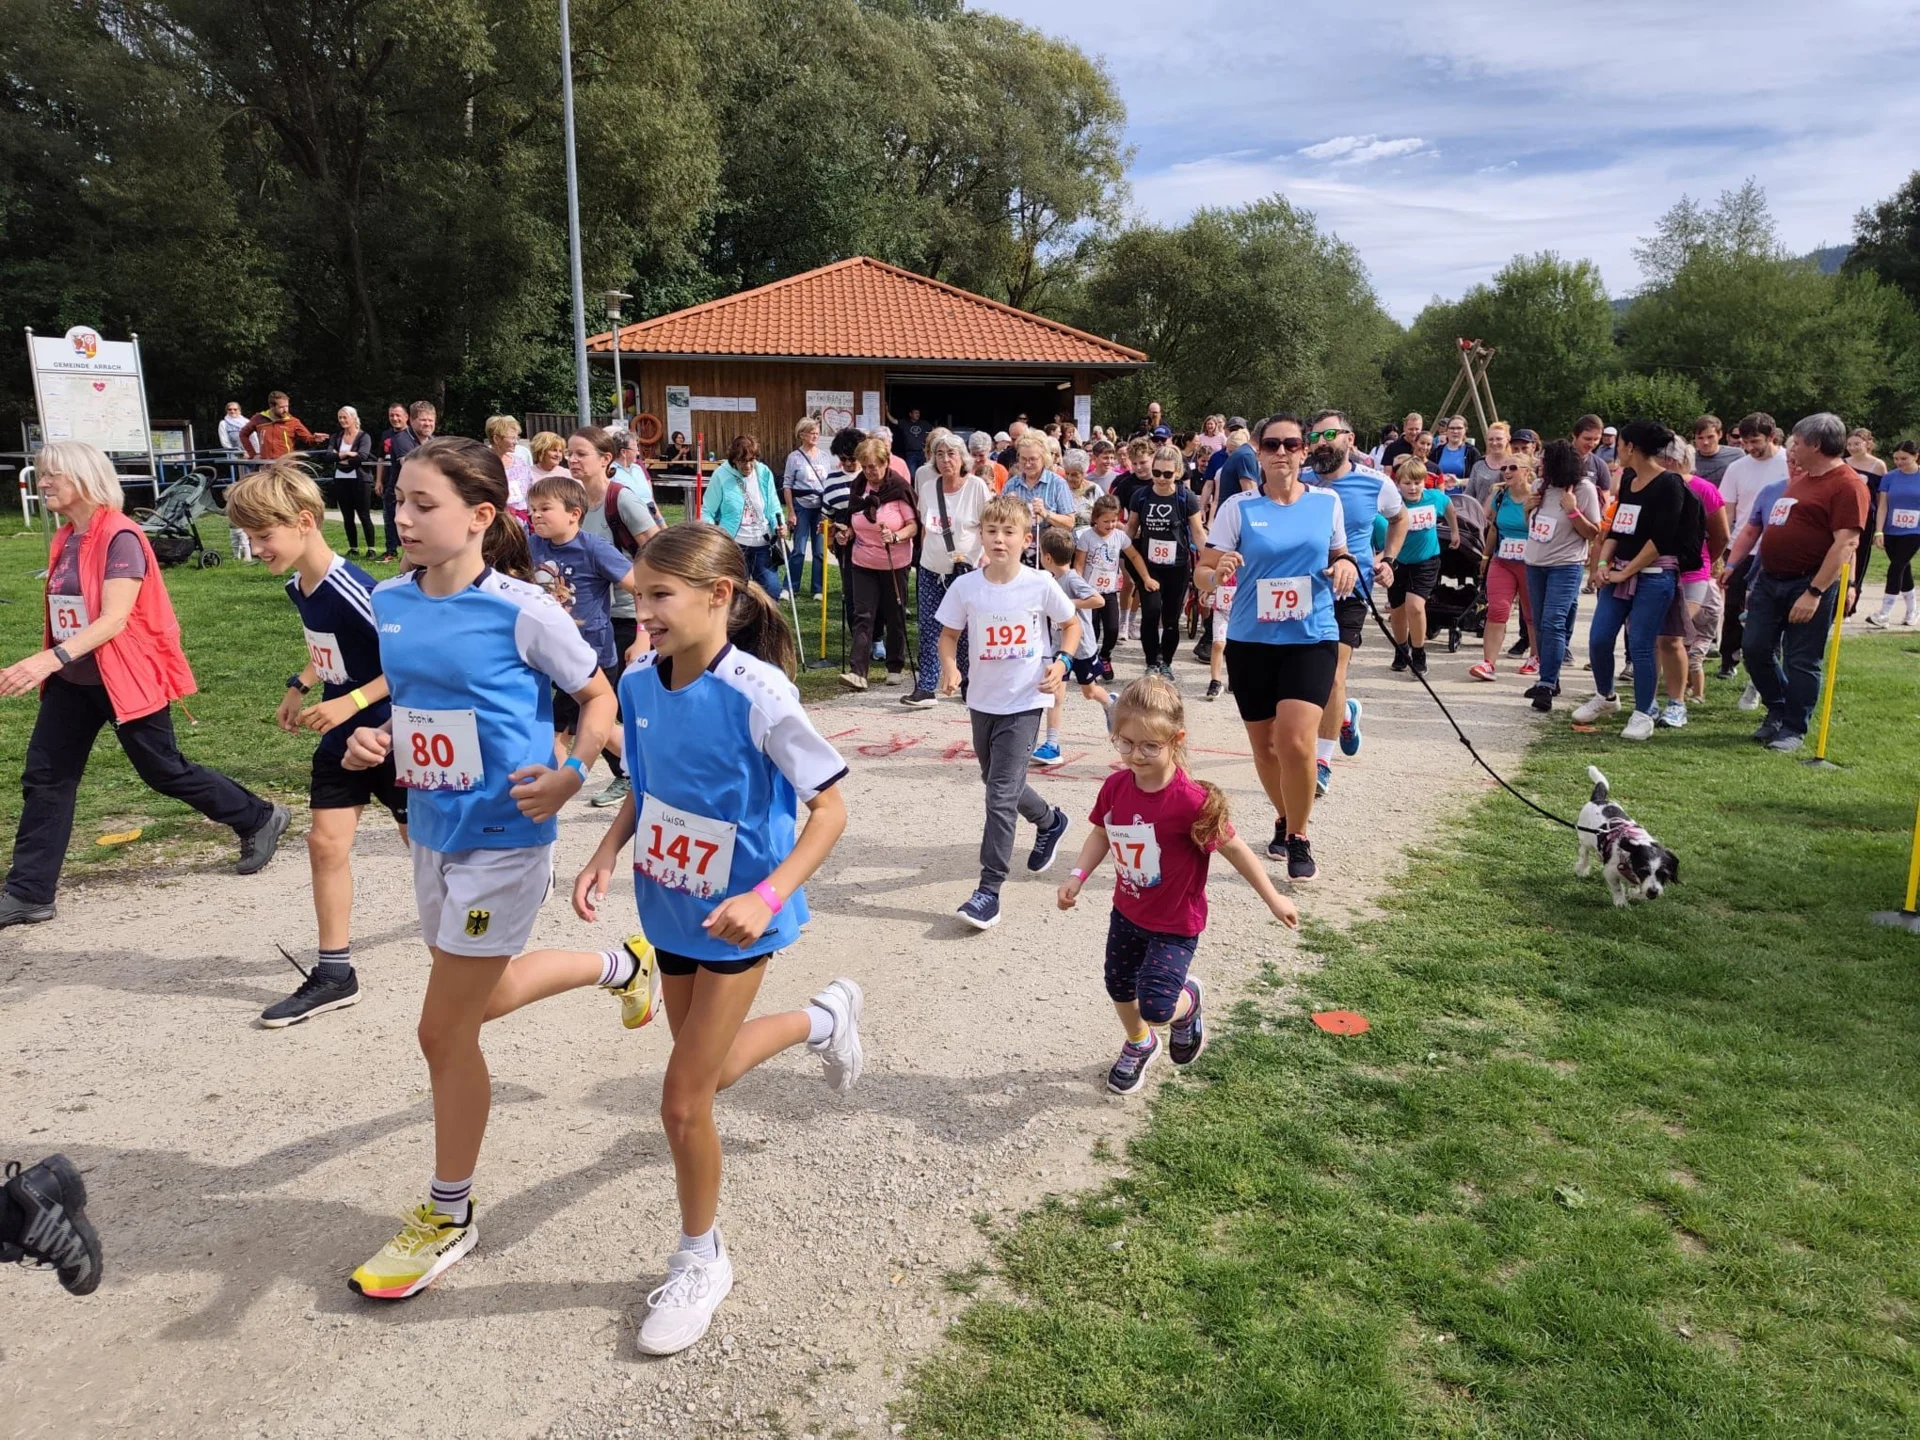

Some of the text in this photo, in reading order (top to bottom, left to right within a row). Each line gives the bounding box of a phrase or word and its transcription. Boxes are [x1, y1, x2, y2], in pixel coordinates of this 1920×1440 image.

[53, 361, 122, 371] GEMEINDE ARRACH
[1146, 503, 1157, 517] I
[1412, 512, 1432, 524] 154
[1616, 512, 1634, 526] 123
[1896, 514, 1915, 524] 102
[1154, 546, 1169, 557] 98
[1503, 543, 1524, 554] 115
[1096, 577, 1111, 588] 99
[1271, 590, 1298, 609] 79
[58, 608, 82, 628] 61
[986, 625, 1027, 646] 192
[408, 711, 434, 726] Sophie
[635, 716, 648, 728] KO
[411, 732, 454, 768] 80
[662, 811, 686, 828] Luisa
[647, 825, 719, 876] 147
